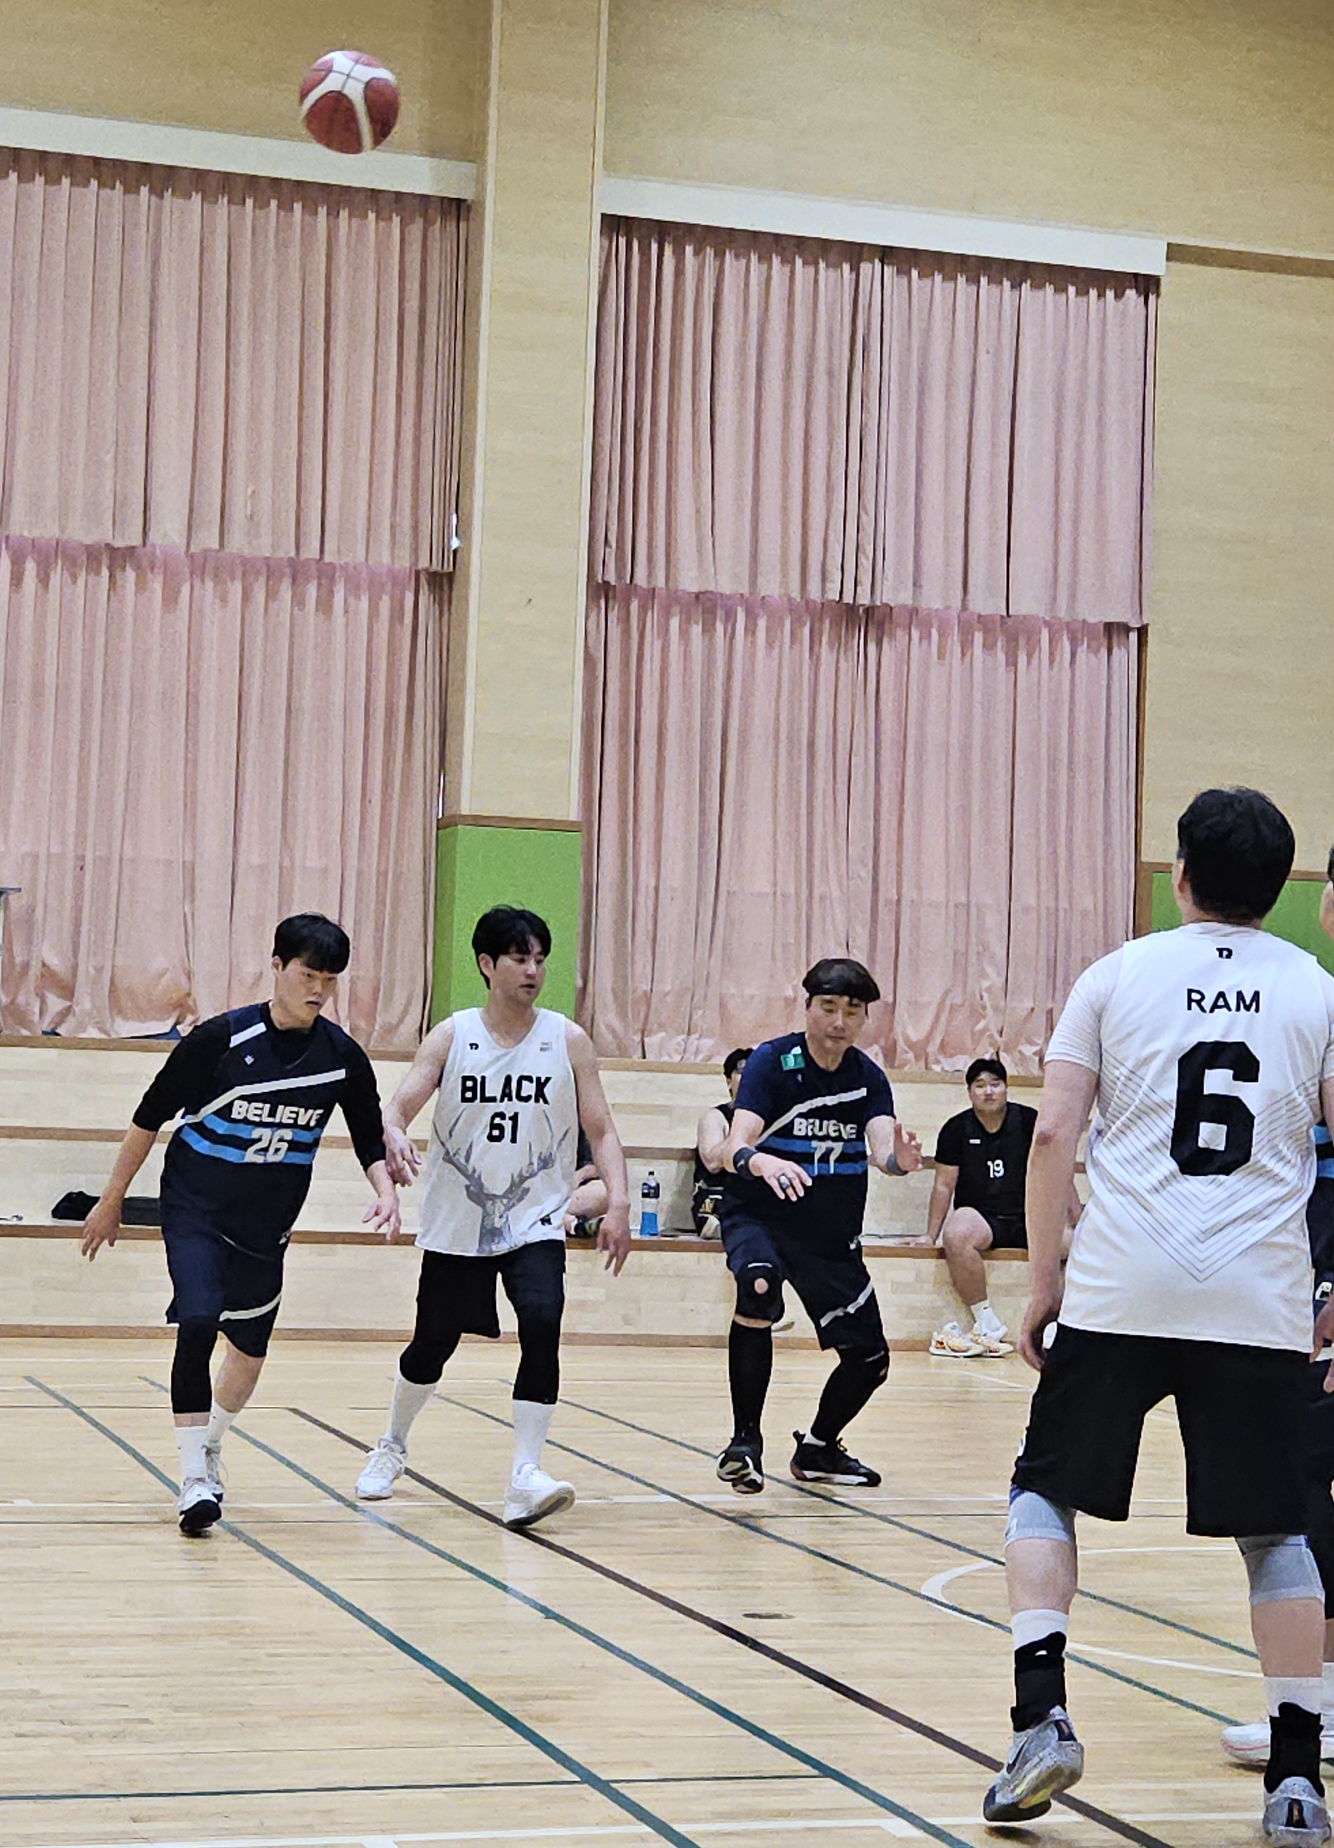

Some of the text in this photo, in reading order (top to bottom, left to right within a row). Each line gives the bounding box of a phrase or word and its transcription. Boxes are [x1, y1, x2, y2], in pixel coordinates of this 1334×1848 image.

[1186, 988, 1261, 1014] RAM
[460, 1074, 553, 1106] BLACK
[1170, 1041, 1260, 1177] 6
[486, 1111, 520, 1144] 61
[244, 1127, 293, 1163] 26
[811, 1139, 845, 1176] 77
[986, 1159, 1005, 1178] 19
